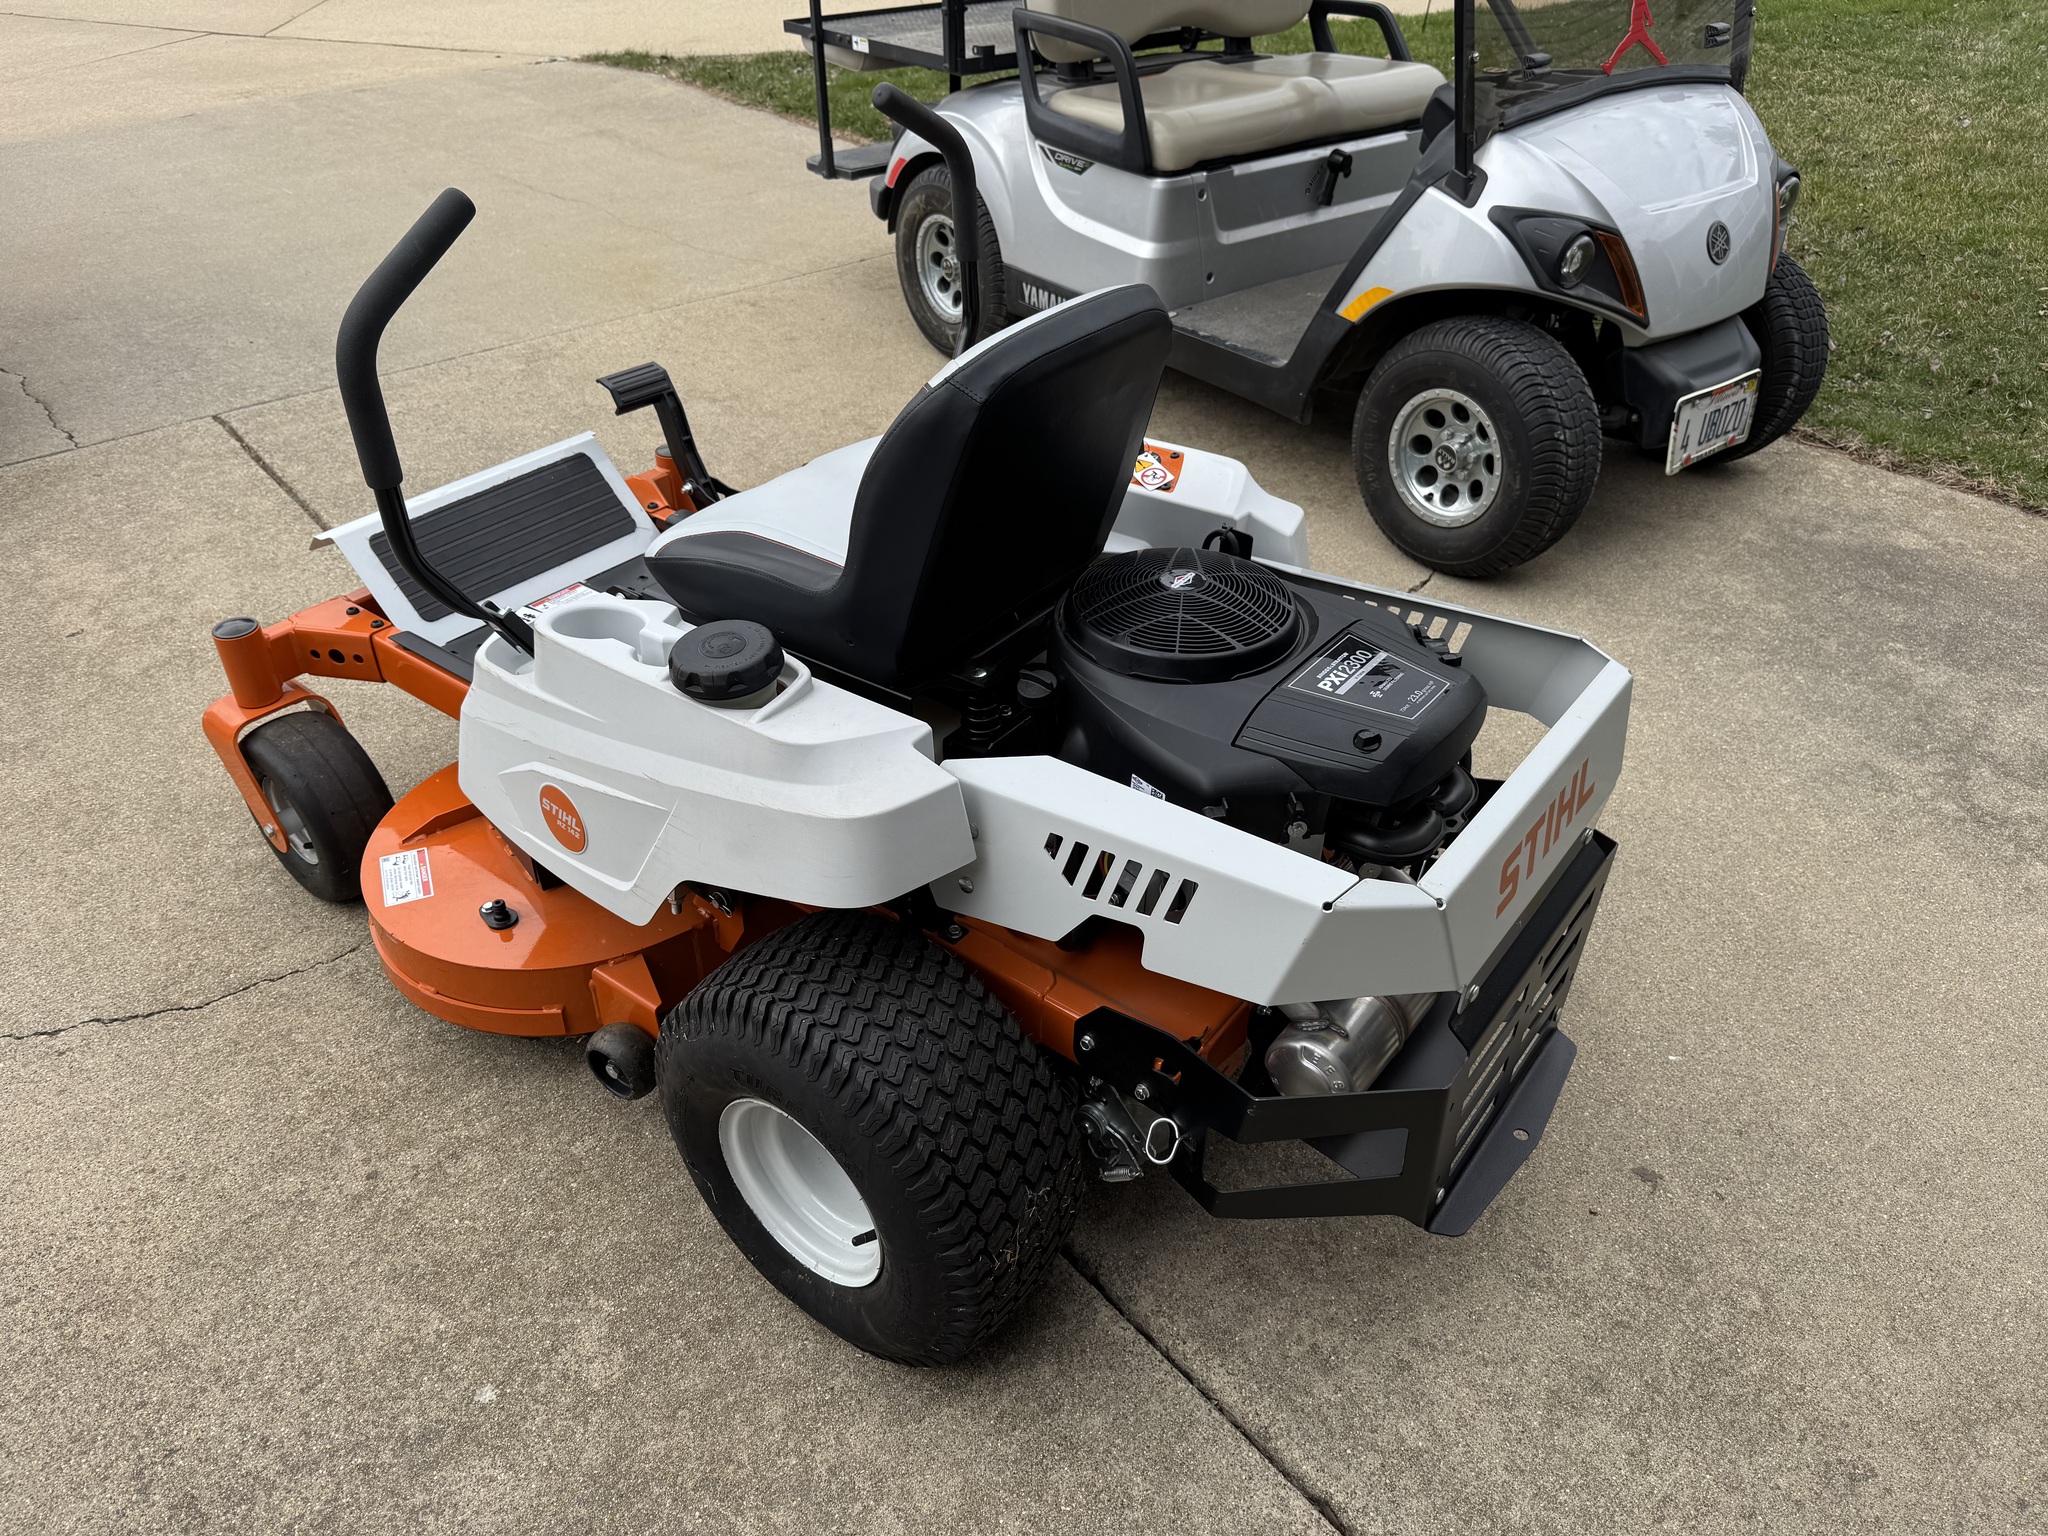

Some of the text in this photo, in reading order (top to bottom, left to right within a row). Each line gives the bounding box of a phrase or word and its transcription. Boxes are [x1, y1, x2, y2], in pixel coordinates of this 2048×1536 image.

[1681, 418, 1690, 452] 4
[542, 797, 581, 832] STIHL
[556, 819, 581, 839] RZ 142
[1496, 757, 1595, 919] STIHL
